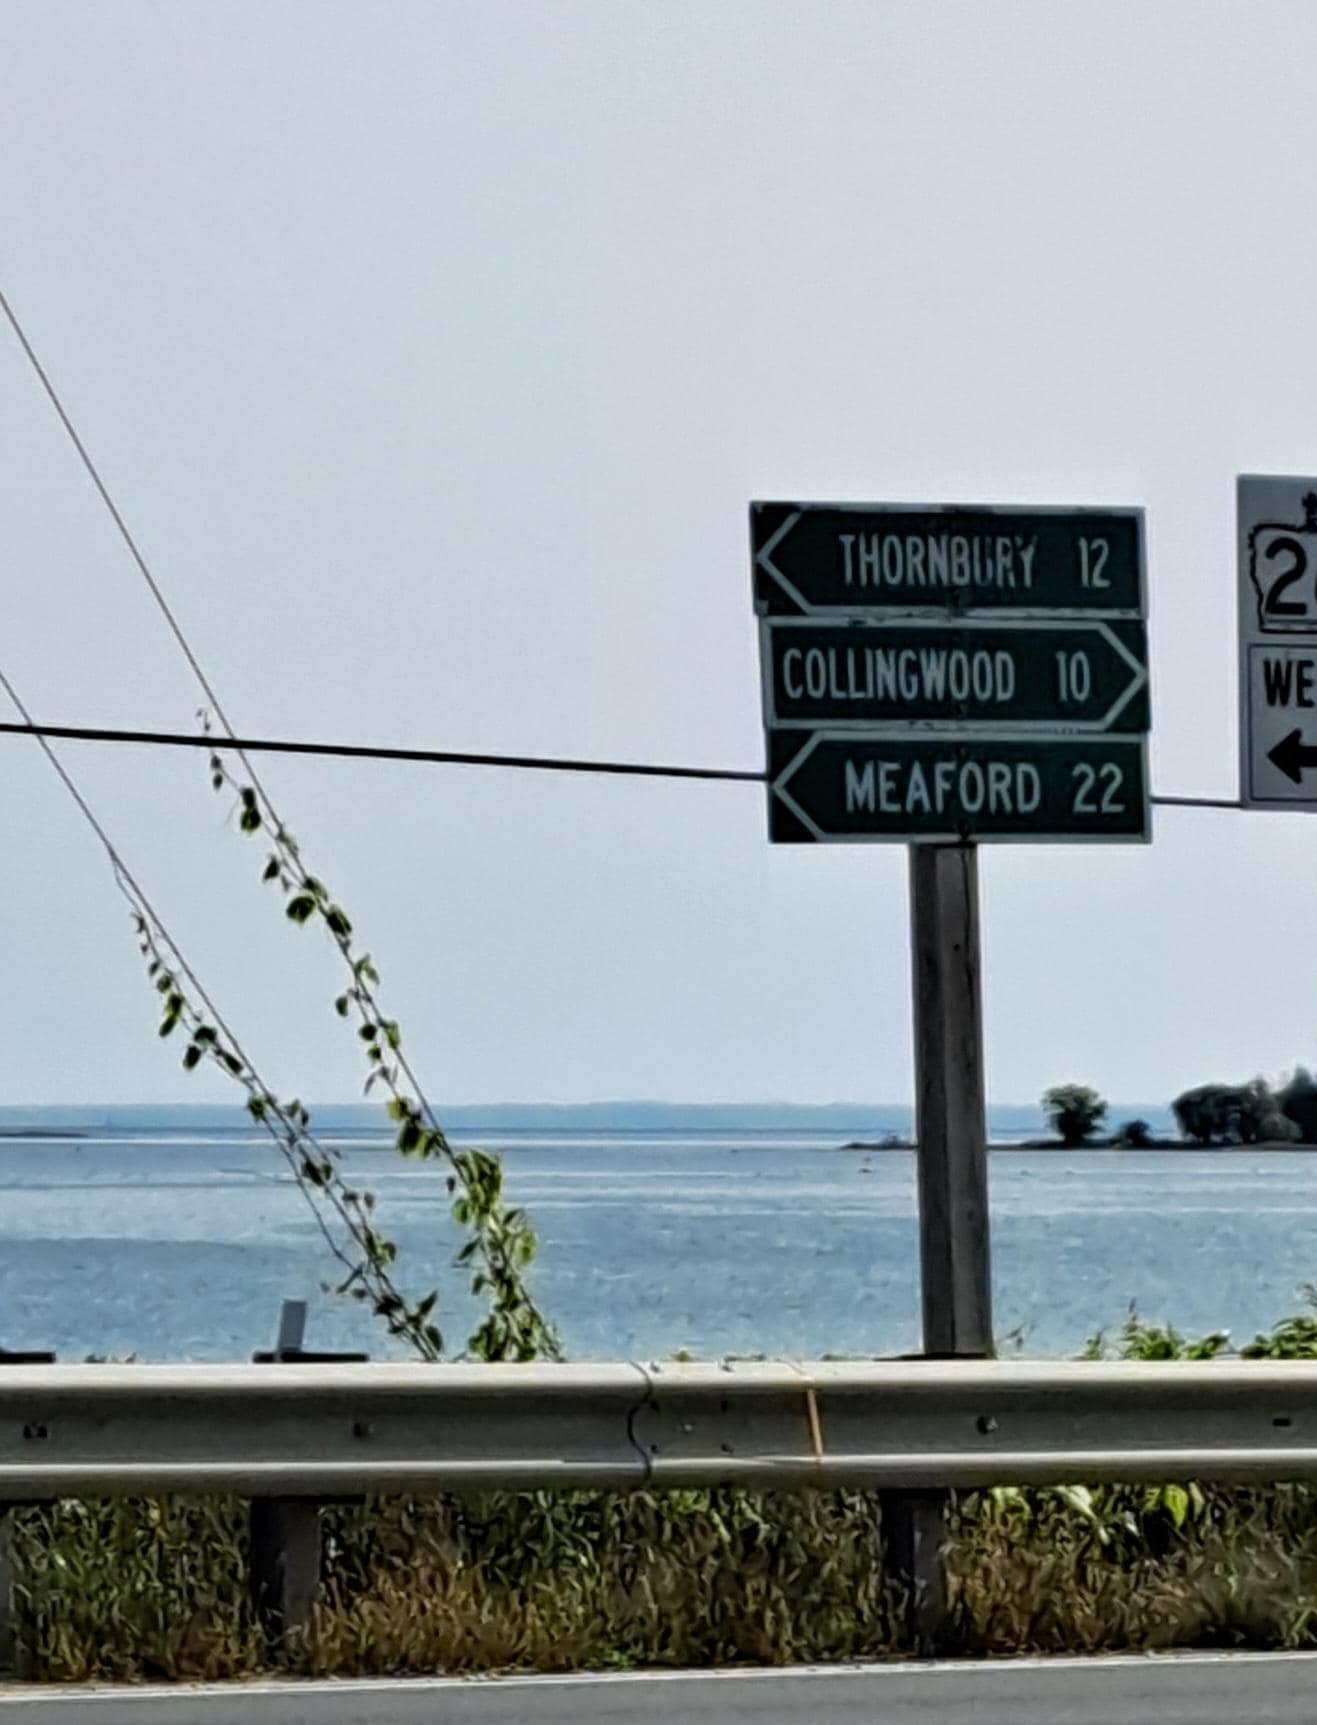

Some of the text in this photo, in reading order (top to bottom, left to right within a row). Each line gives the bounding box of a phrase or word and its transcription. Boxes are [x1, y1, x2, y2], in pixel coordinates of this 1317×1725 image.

[838, 533, 1112, 589] THORNBURY 12
[782, 647, 1092, 702] COLLINGWOOD 10
[844, 760, 1126, 814] MEAFORD 22
